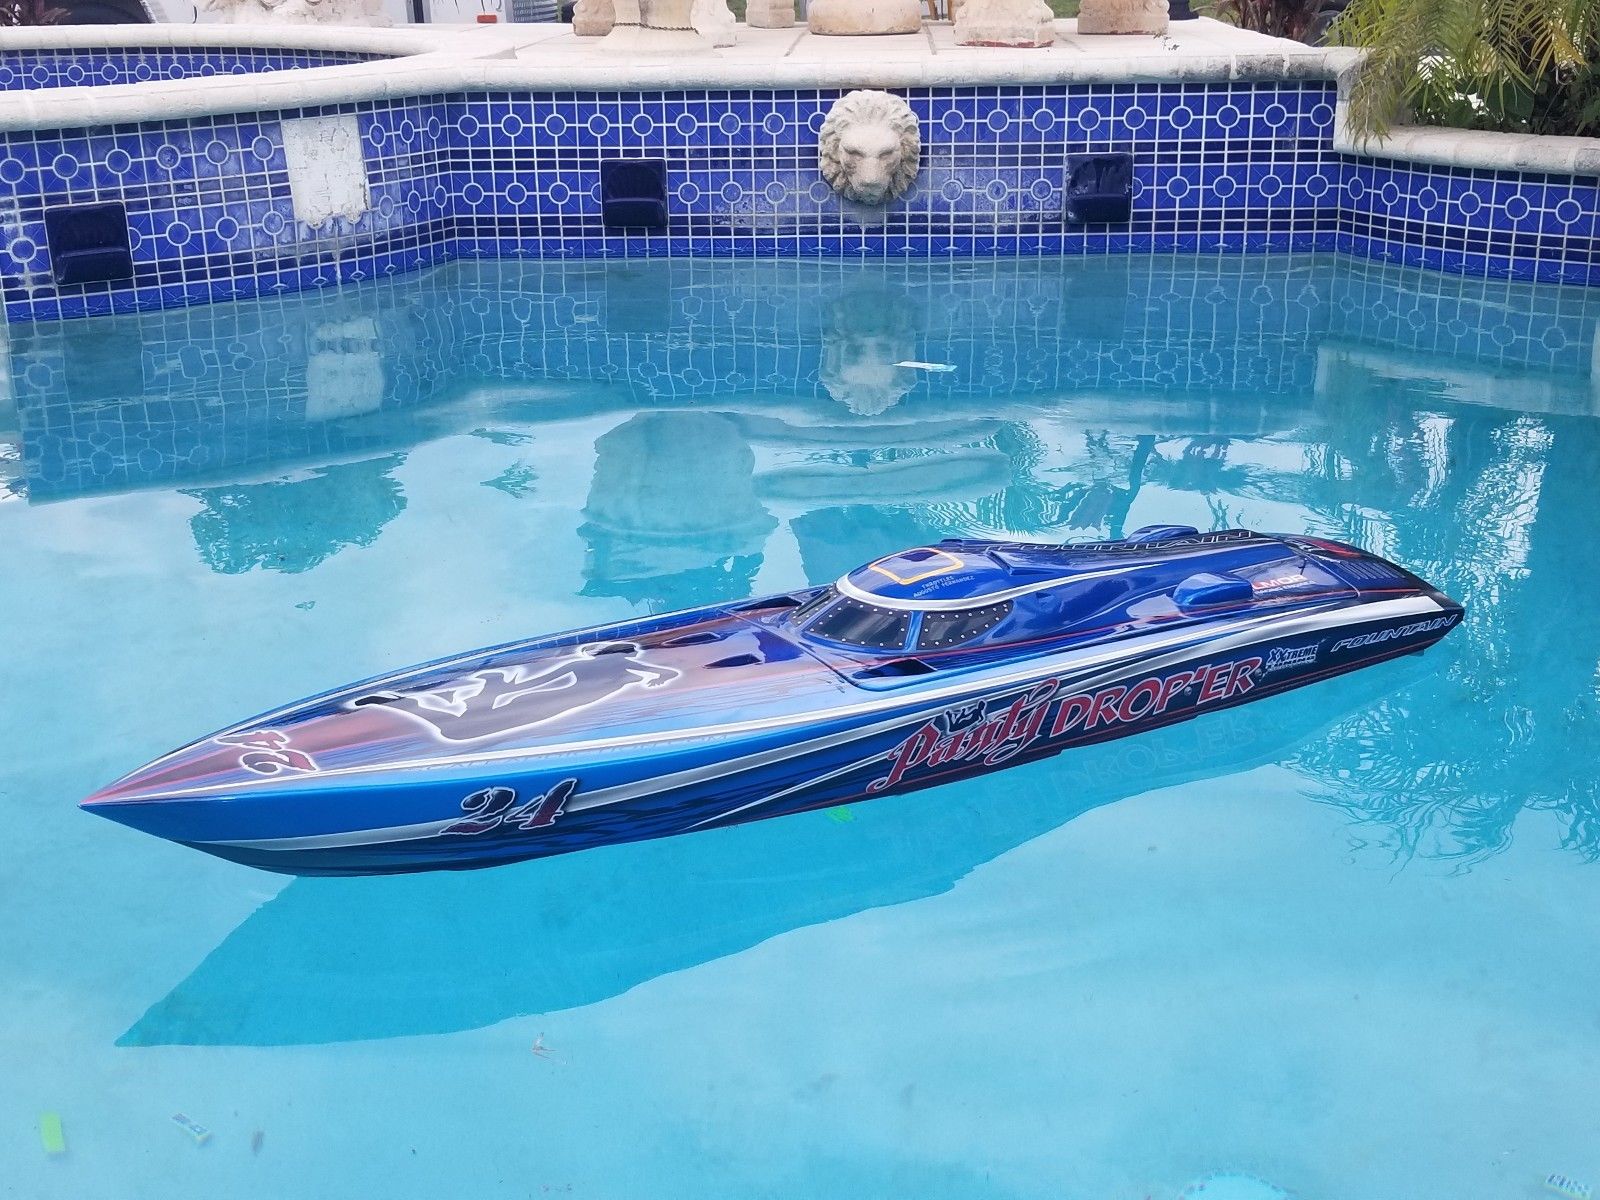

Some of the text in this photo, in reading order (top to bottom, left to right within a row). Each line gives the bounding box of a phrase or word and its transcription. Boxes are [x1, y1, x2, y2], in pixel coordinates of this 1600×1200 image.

[1330, 613, 1458, 653] FOUNTAIN
[866, 678, 1060, 794] Panty
[438, 778, 579, 836] 24
